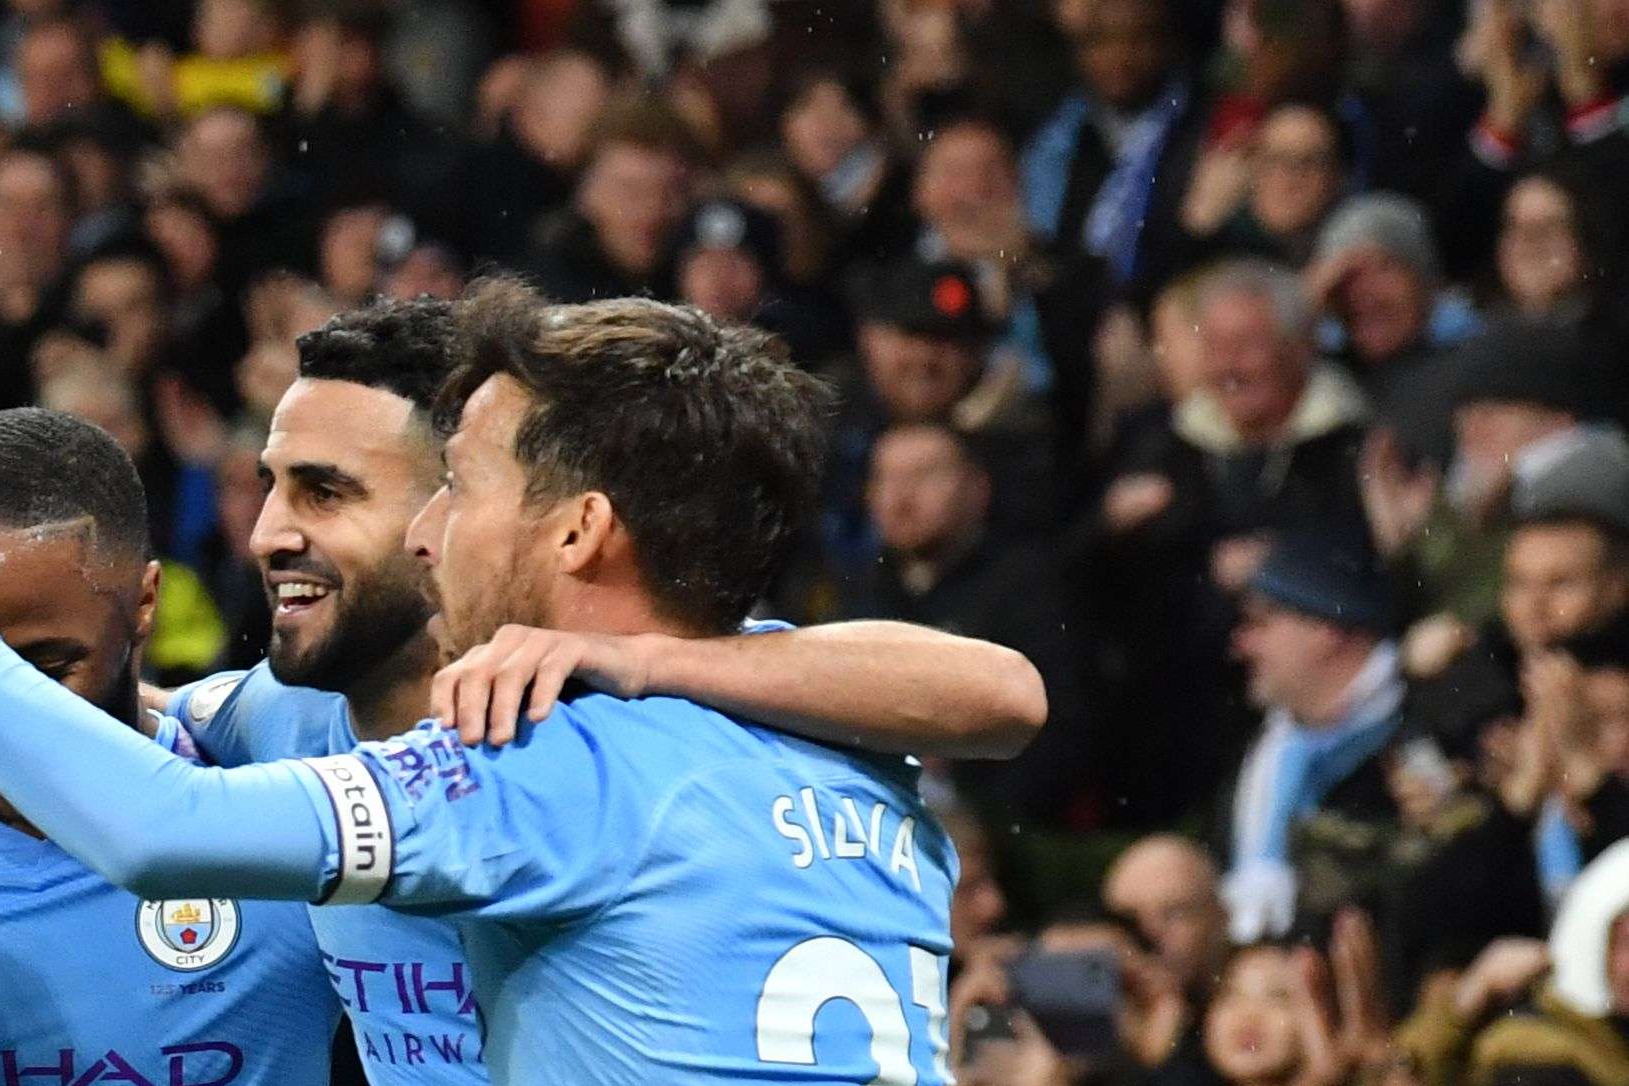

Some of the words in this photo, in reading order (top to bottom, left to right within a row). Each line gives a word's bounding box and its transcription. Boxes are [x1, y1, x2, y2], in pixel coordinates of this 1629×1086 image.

[325, 763, 384, 871] ptain
[772, 785, 923, 893] SILVA
[175, 954, 206, 966] CITY
